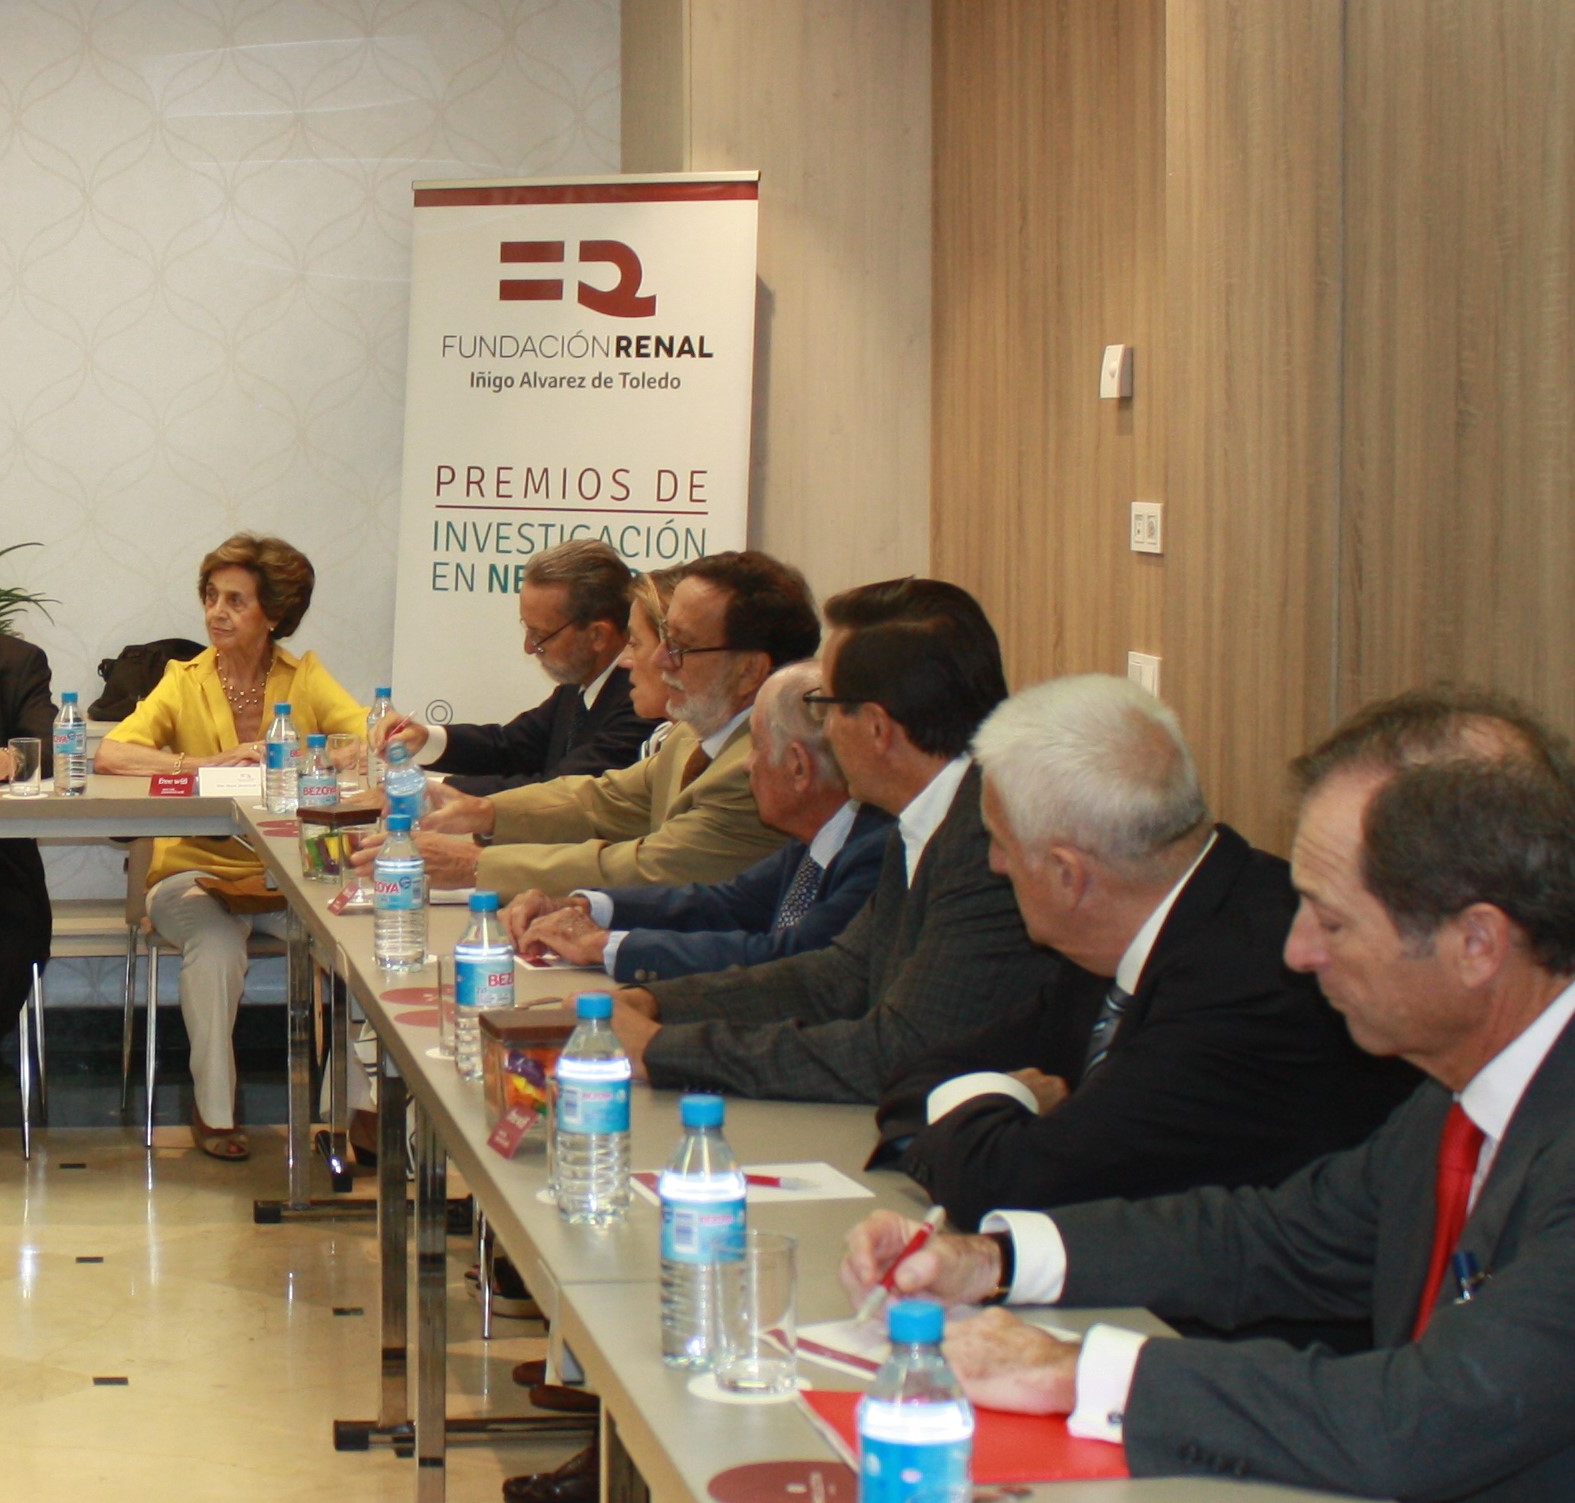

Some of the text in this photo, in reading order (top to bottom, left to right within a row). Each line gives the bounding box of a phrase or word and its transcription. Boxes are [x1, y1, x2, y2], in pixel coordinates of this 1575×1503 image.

[469, 371, 682, 394] Iñigo Alvarez de Toledo
[434, 464, 709, 503] PREMIOS DE
[431, 562, 475, 592] EN
